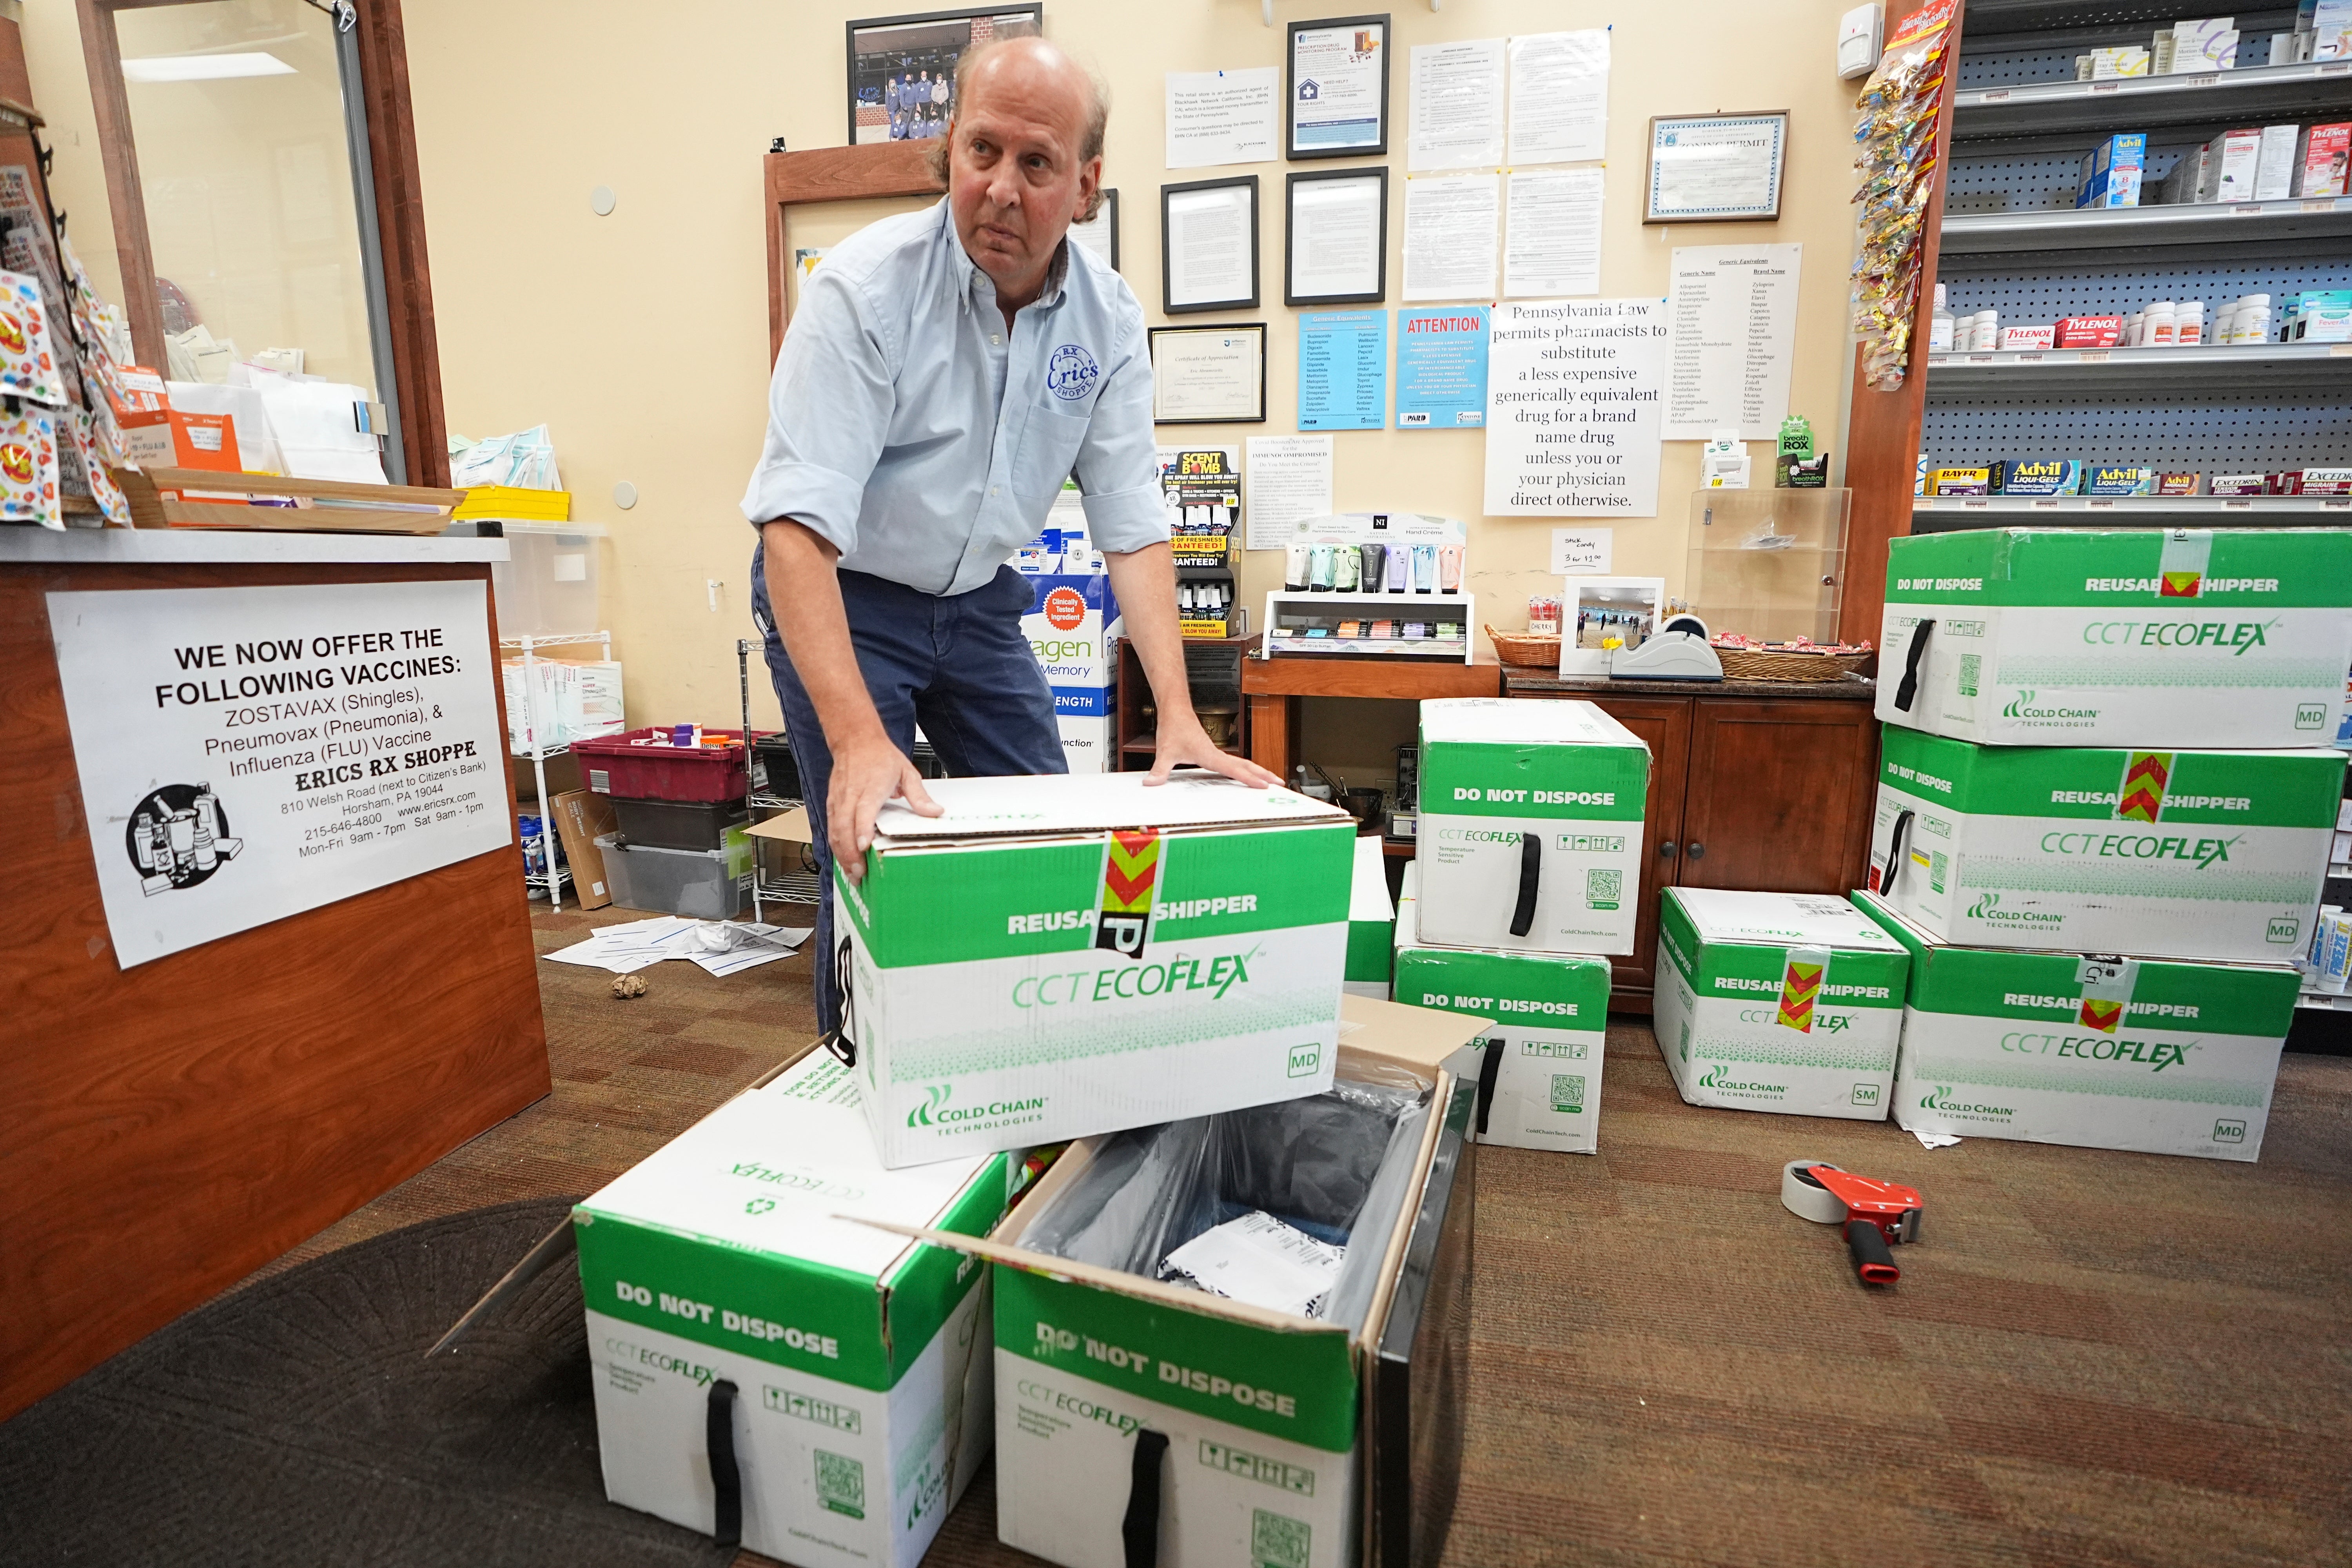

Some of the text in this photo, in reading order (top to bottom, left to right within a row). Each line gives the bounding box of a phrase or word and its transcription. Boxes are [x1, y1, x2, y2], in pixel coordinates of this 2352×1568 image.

[2312, 129, 2348, 138] TYLENOL
[1513, 303, 1649, 321] Pennsylvania Law
[1407, 317, 1479, 333] ATTENTION
[2067, 319, 2118, 330] TYLENOL
[1493, 325, 1667, 343] permits pharmacists to
[2008, 329, 2051, 338] TYLENOL
[1541, 346, 1616, 359] substitute
[1048, 355, 1098, 389] Eric's
[1519, 367, 1637, 383] a less expensive
[1056, 381, 1091, 396] SHOPPE
[1495, 388, 1659, 405] generically equivalent
[1515, 409, 1636, 426] drug for a brand
[1535, 430, 1615, 446] name drug
[1784, 441, 1808, 450] ROX
[1182, 453, 1221, 463] SCENT
[1525, 451, 1622, 467] unless you or
[2013, 462, 2062, 475] Advil
[1518, 472, 1625, 488] your physician
[1511, 493, 1632, 506] direct otherwise.
[1897, 578, 1982, 590] DO NOT DISPOSE
[1052, 598, 1078, 606] Clinically
[1051, 613, 1080, 622] Ingredient
[175, 629, 443, 670] WE NOW OFFER THE
[156, 657, 461, 708] FOLLOWING VACCINES:
[225, 686, 424, 728] ZOSTAVAX (Shingles),
[2023, 709, 2096, 718] COLD CHAIN
[2299, 711, 2322, 723] MD
[205, 705, 443, 755] Pneumovax (Pneumonia), &
[230, 730, 432, 777] Influenza (FLU) Vaccine
[296, 741, 477, 791] ERICS RX SHOPPE
[281, 760, 486, 814] 810 Welsh Road (next to Citizen's Bank)
[342, 784, 443, 816] Horsham, PA 19044
[1454, 788, 1615, 805] DO NOT DISPOSE
[2161, 795, 2250, 810] SHIPPER
[305, 791, 476, 841] 215-646-4800 www.ericsrx.com
[299, 802, 483, 858] Mon-Fri 9am 7pm Sat 9am 1pm
[1008, 895, 1258, 935] REUSA SHIPPER
[2330, 934, 2348, 976] FREEZE
[1291, 1053, 1317, 1070] MD
[1718, 1080, 1785, 1092] COLD CHAIN
[1717, 1091, 1783, 1100] TECHNOLOGIES
[1856, 1090, 1875, 1099] SM
[938, 1098, 1043, 1123] COLD CHAIN
[938, 1115, 1043, 1136] TECHNOLOGIES
[616, 1281, 839, 1359] DO NOT DISPOSE
[1036, 1322, 1296, 1418] DO NOT DISPOSE
